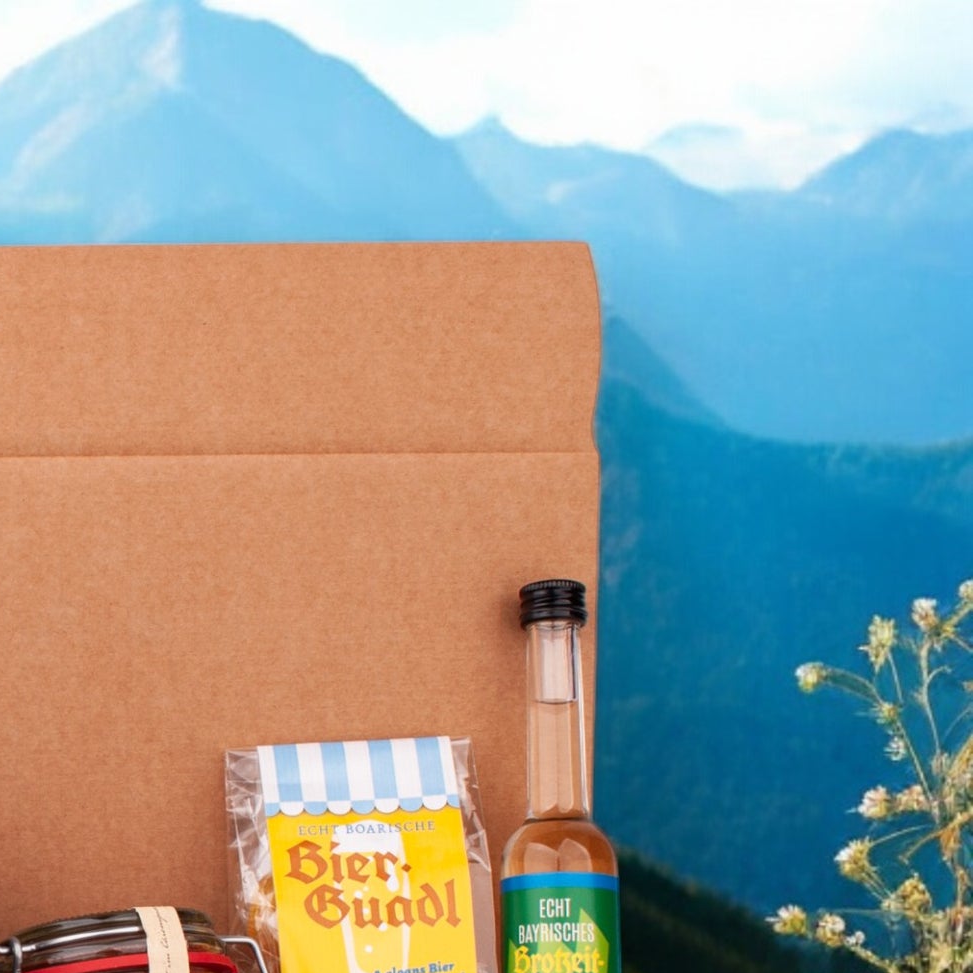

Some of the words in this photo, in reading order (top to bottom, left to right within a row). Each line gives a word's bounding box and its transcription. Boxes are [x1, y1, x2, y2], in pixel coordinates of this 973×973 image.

[298, 824, 339, 837] ECHT
[345, 820, 436, 835] BOARISCHE
[304, 878, 462, 929] Guadl
[539, 898, 571, 919] ECHT
[518, 921, 595, 945] BAYRISCHES
